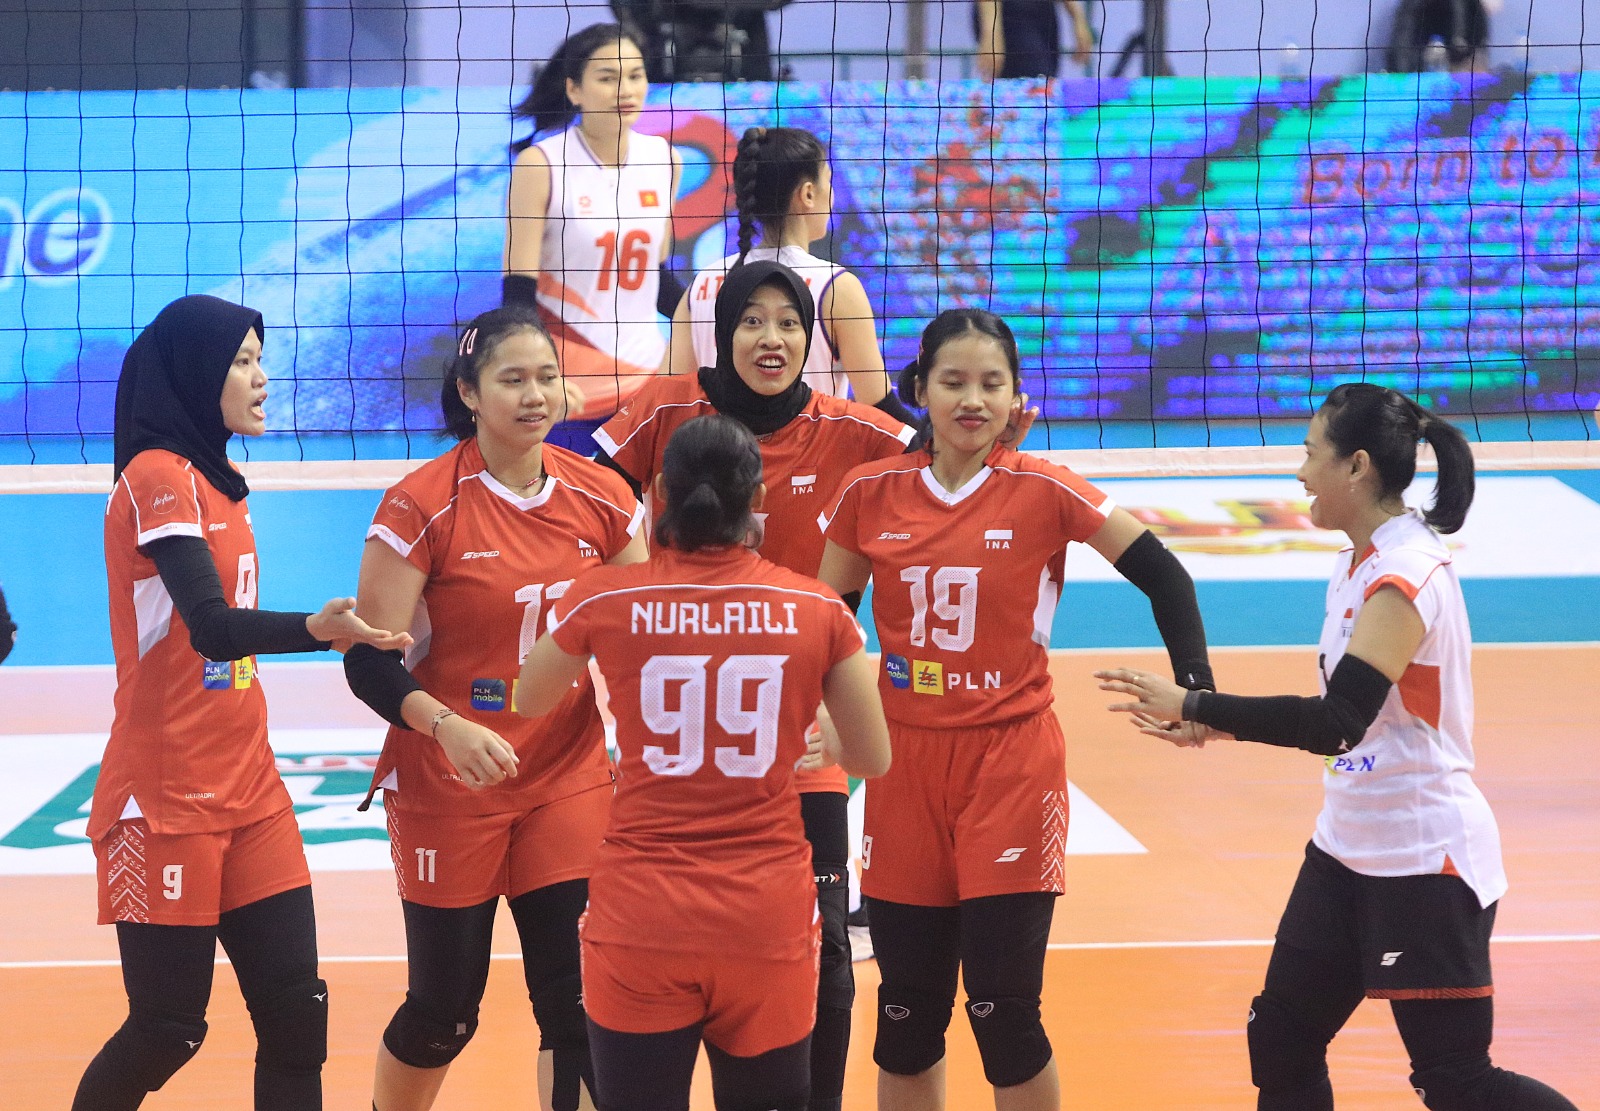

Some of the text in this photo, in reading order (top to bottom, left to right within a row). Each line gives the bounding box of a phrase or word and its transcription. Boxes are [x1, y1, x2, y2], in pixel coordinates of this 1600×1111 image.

[1303, 150, 1468, 203] Born
[1501, 134, 1564, 180] to
[595, 229, 651, 292] 16
[792, 486, 814, 495] INA
[580, 549, 598, 558] INA
[985, 541, 1010, 549] INA
[472, 551, 500, 559] SPEED
[631, 601, 799, 634] NURLAILI
[900, 565, 982, 652] 19
[204, 672, 230, 682] mobile
[205, 666, 220, 674] PLN
[947, 670, 1001, 689] PLN
[473, 694, 503, 702] mobile
[640, 654, 790, 778] 99
[1333, 755, 1376, 772] PLN
[415, 847, 437, 883] 11
[162, 864, 184, 900] 9
